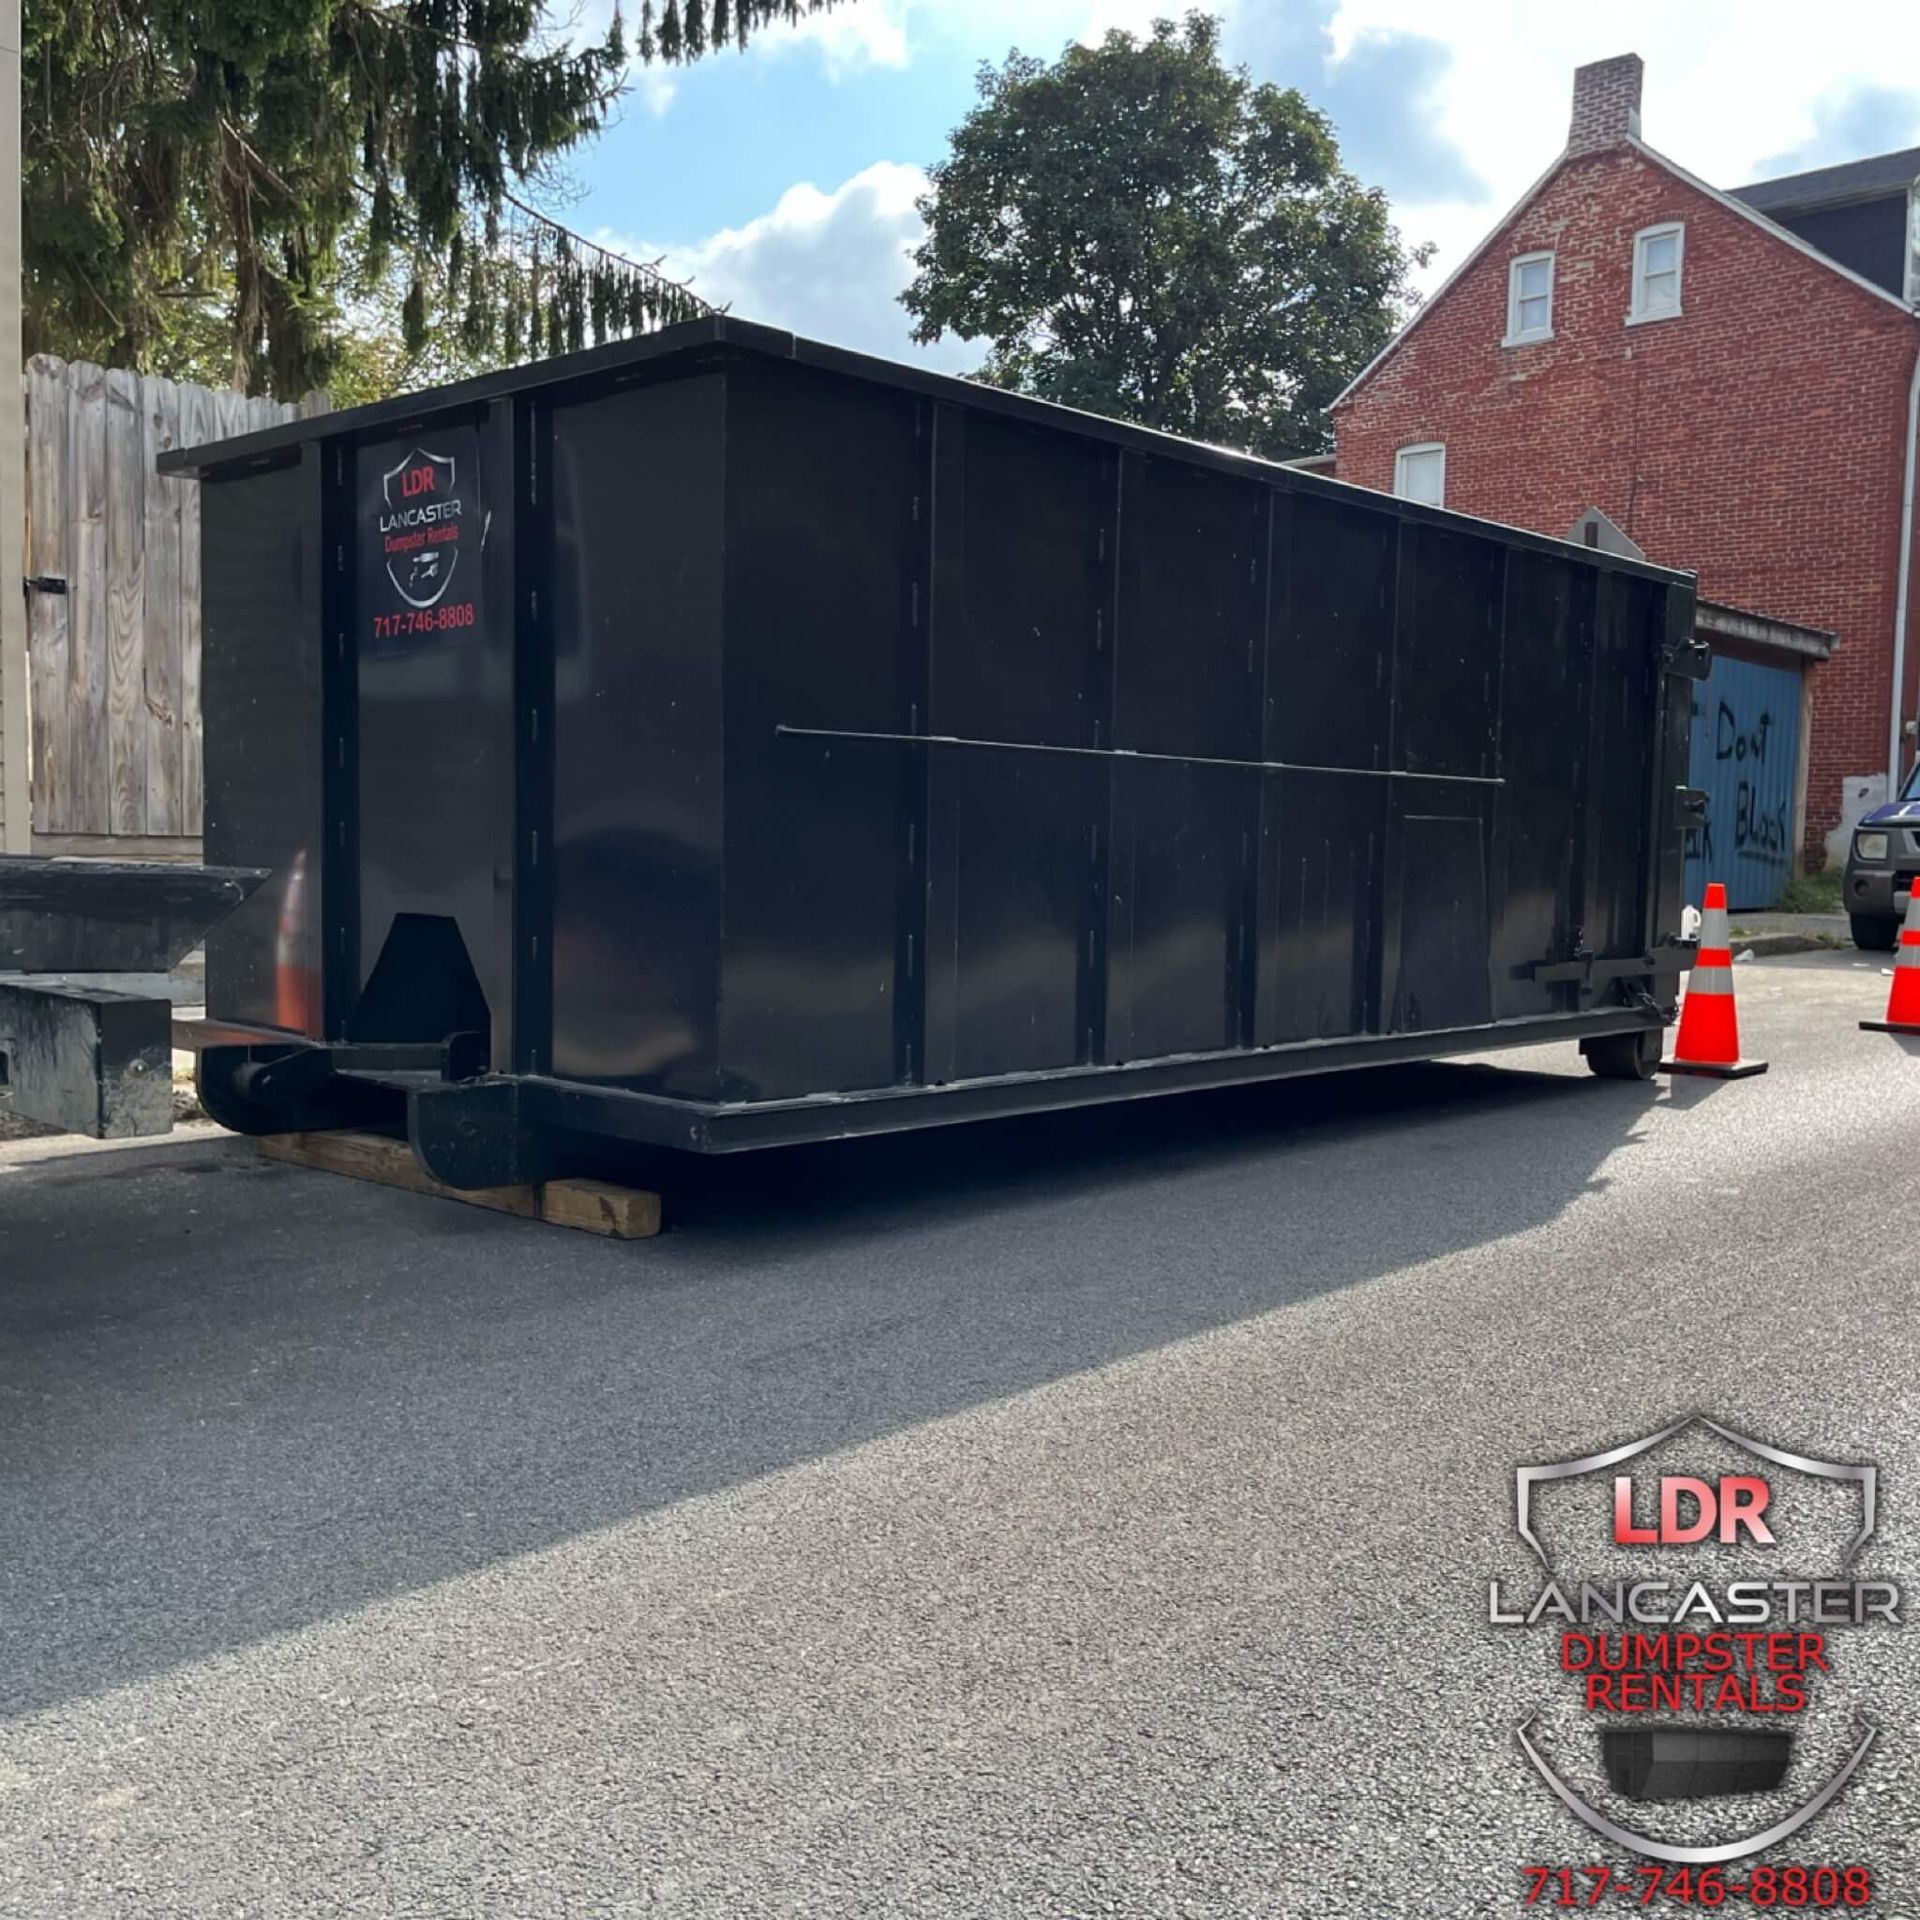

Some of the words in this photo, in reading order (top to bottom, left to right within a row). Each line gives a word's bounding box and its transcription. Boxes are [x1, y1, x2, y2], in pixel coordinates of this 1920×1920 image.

[402, 467, 434, 497] LDR
[379, 500, 462, 532] LANCASTER
[384, 530, 426, 552] Dumpster
[427, 524, 459, 546] Rentals
[374, 604, 474, 638] 717-746-8808
